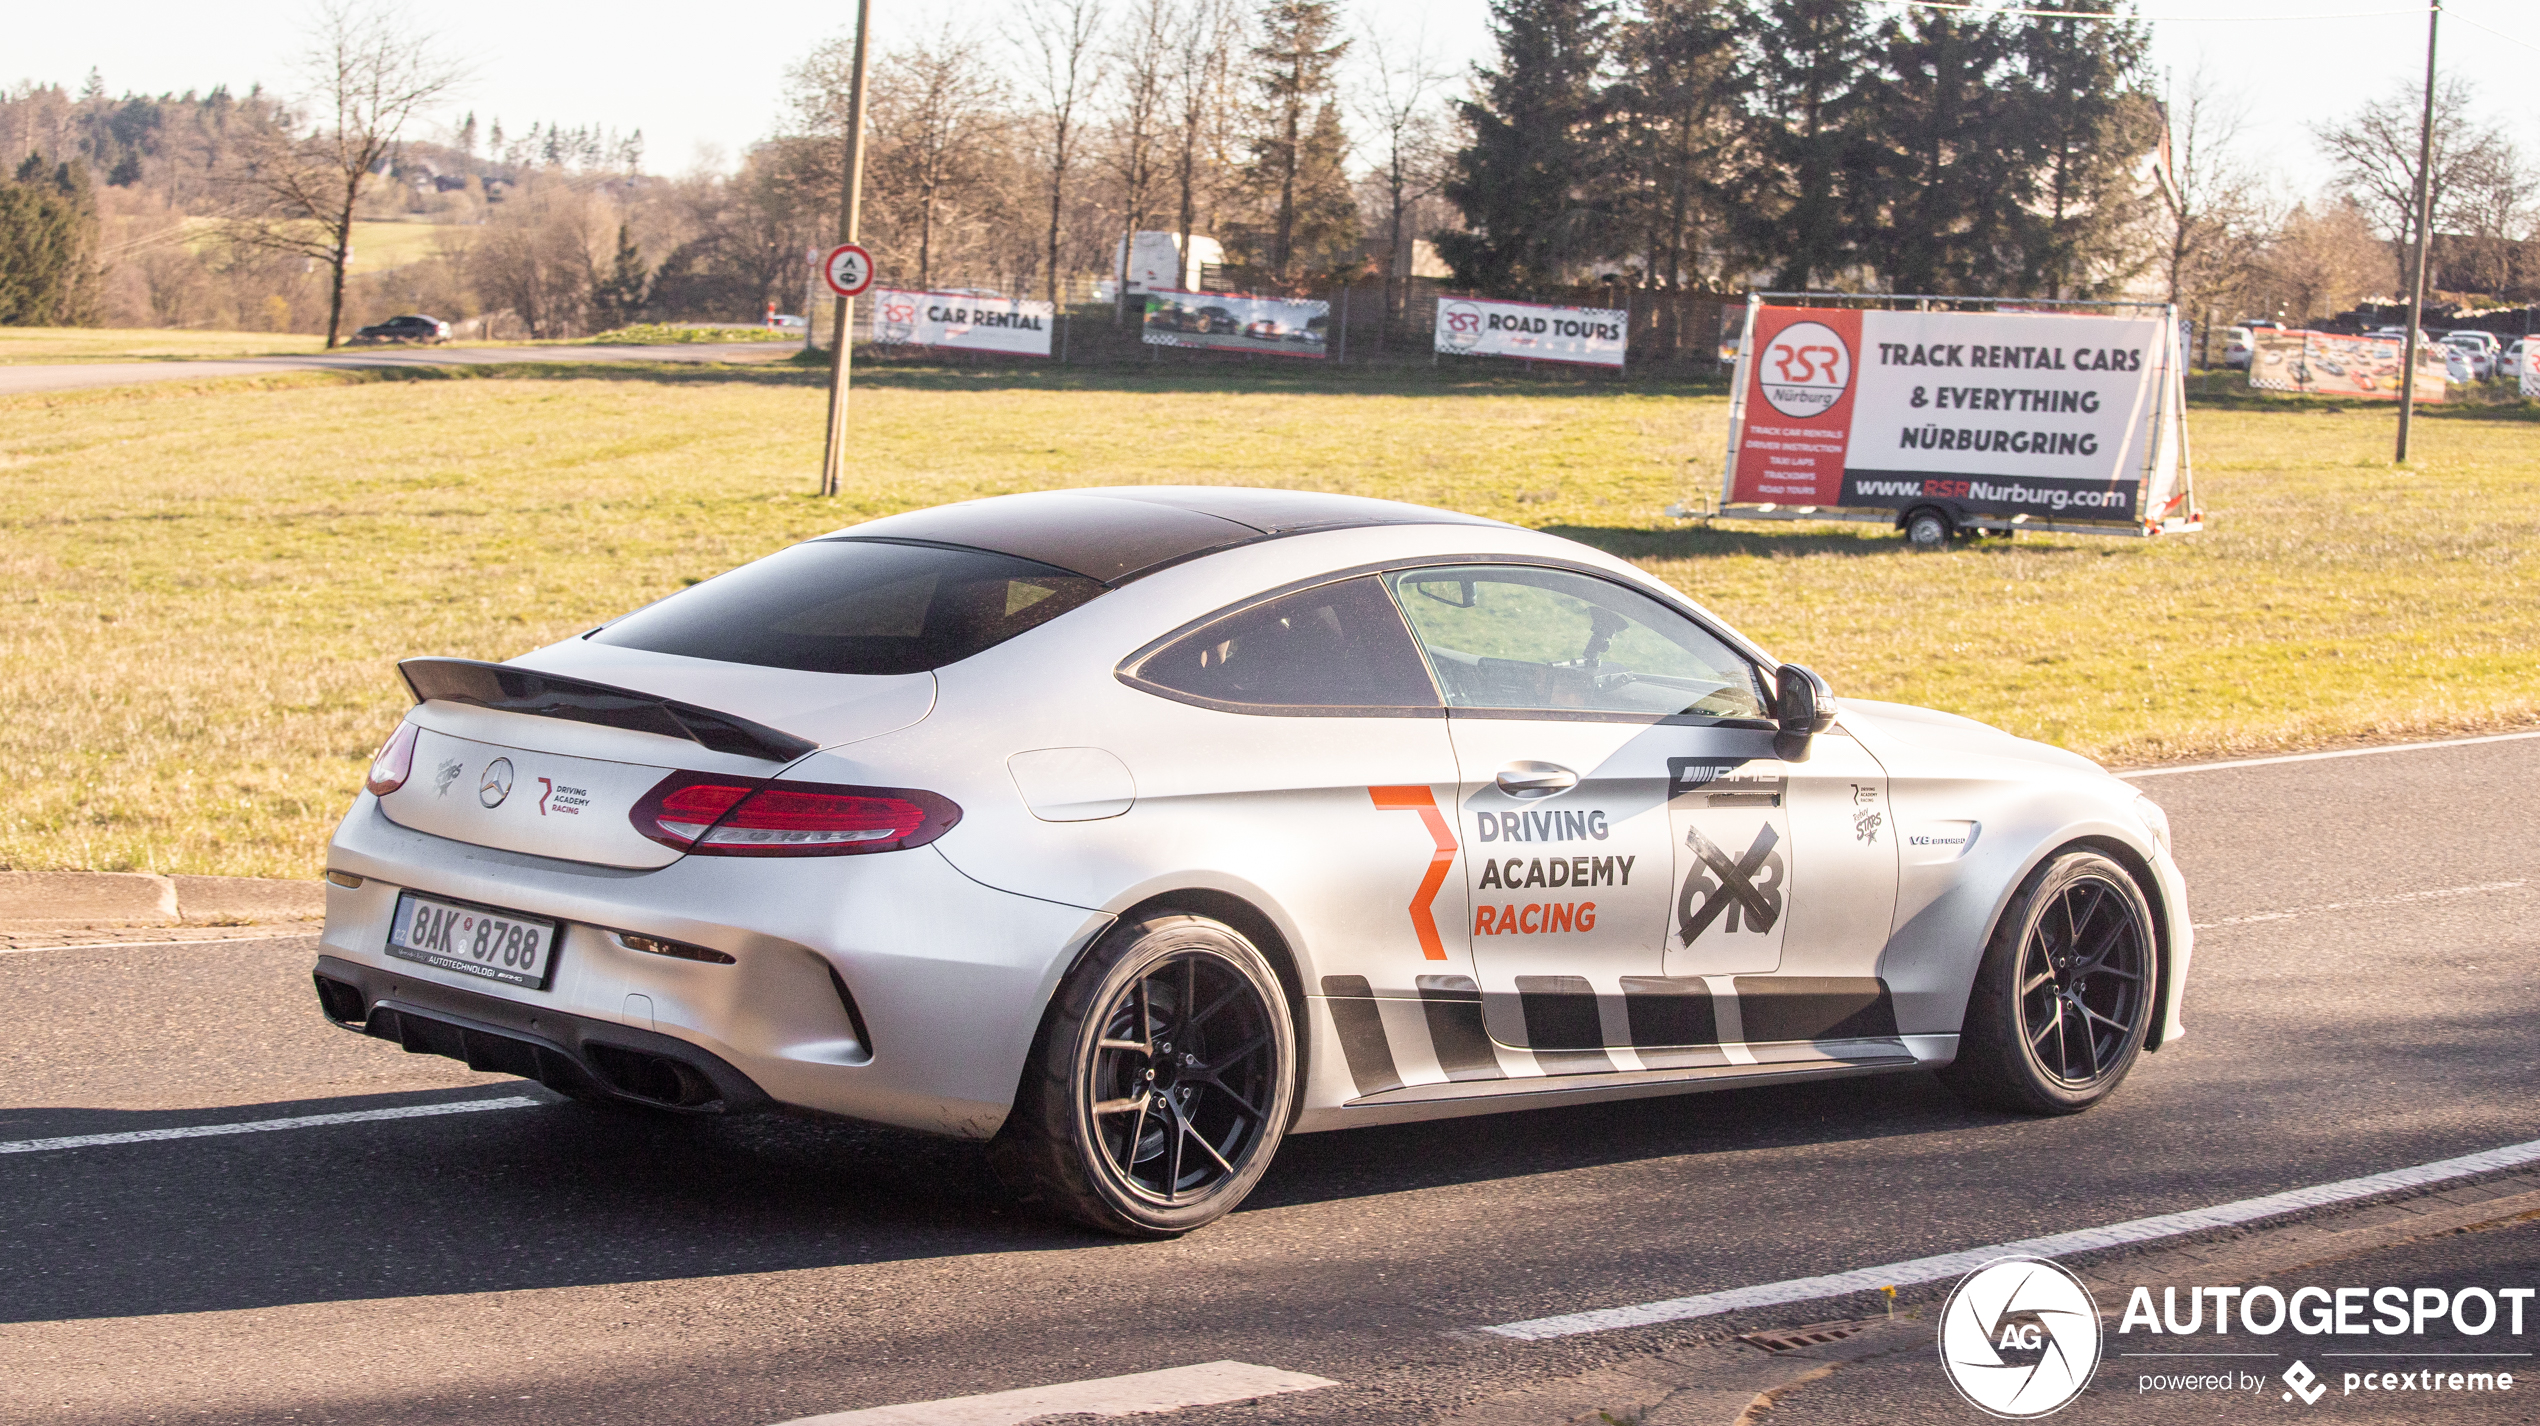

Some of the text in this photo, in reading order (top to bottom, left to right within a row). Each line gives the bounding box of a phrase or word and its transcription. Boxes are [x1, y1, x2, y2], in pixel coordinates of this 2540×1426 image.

[927, 306, 1043, 331] CAR RENTAL
[1488, 313, 1620, 340] ROAD TOURS
[1774, 344, 1839, 384] RSR
[1879, 343, 2140, 372] TRACK RENTAL CARS
[1773, 388, 1832, 408] Nürburg
[1910, 386, 2100, 413] & EVERYTHING
[1900, 424, 2099, 456] NÜRBURGRING
[1856, 480, 2126, 510] www.RSRNurburg.com
[553, 795, 591, 807] ACADEMY
[556, 785, 587, 797] DRIVING
[552, 804, 580, 815] RACING
[1477, 810, 1609, 842] DRIVING
[1909, 836, 1930, 846] V8
[1479, 856, 1635, 889] ACADEMY
[1474, 902, 1596, 936] RACING
[394, 929, 406, 941] CZ
[412, 906, 539, 970] 8AK 8788
[428, 955, 495, 977] AUTOTECHNOLOGI
